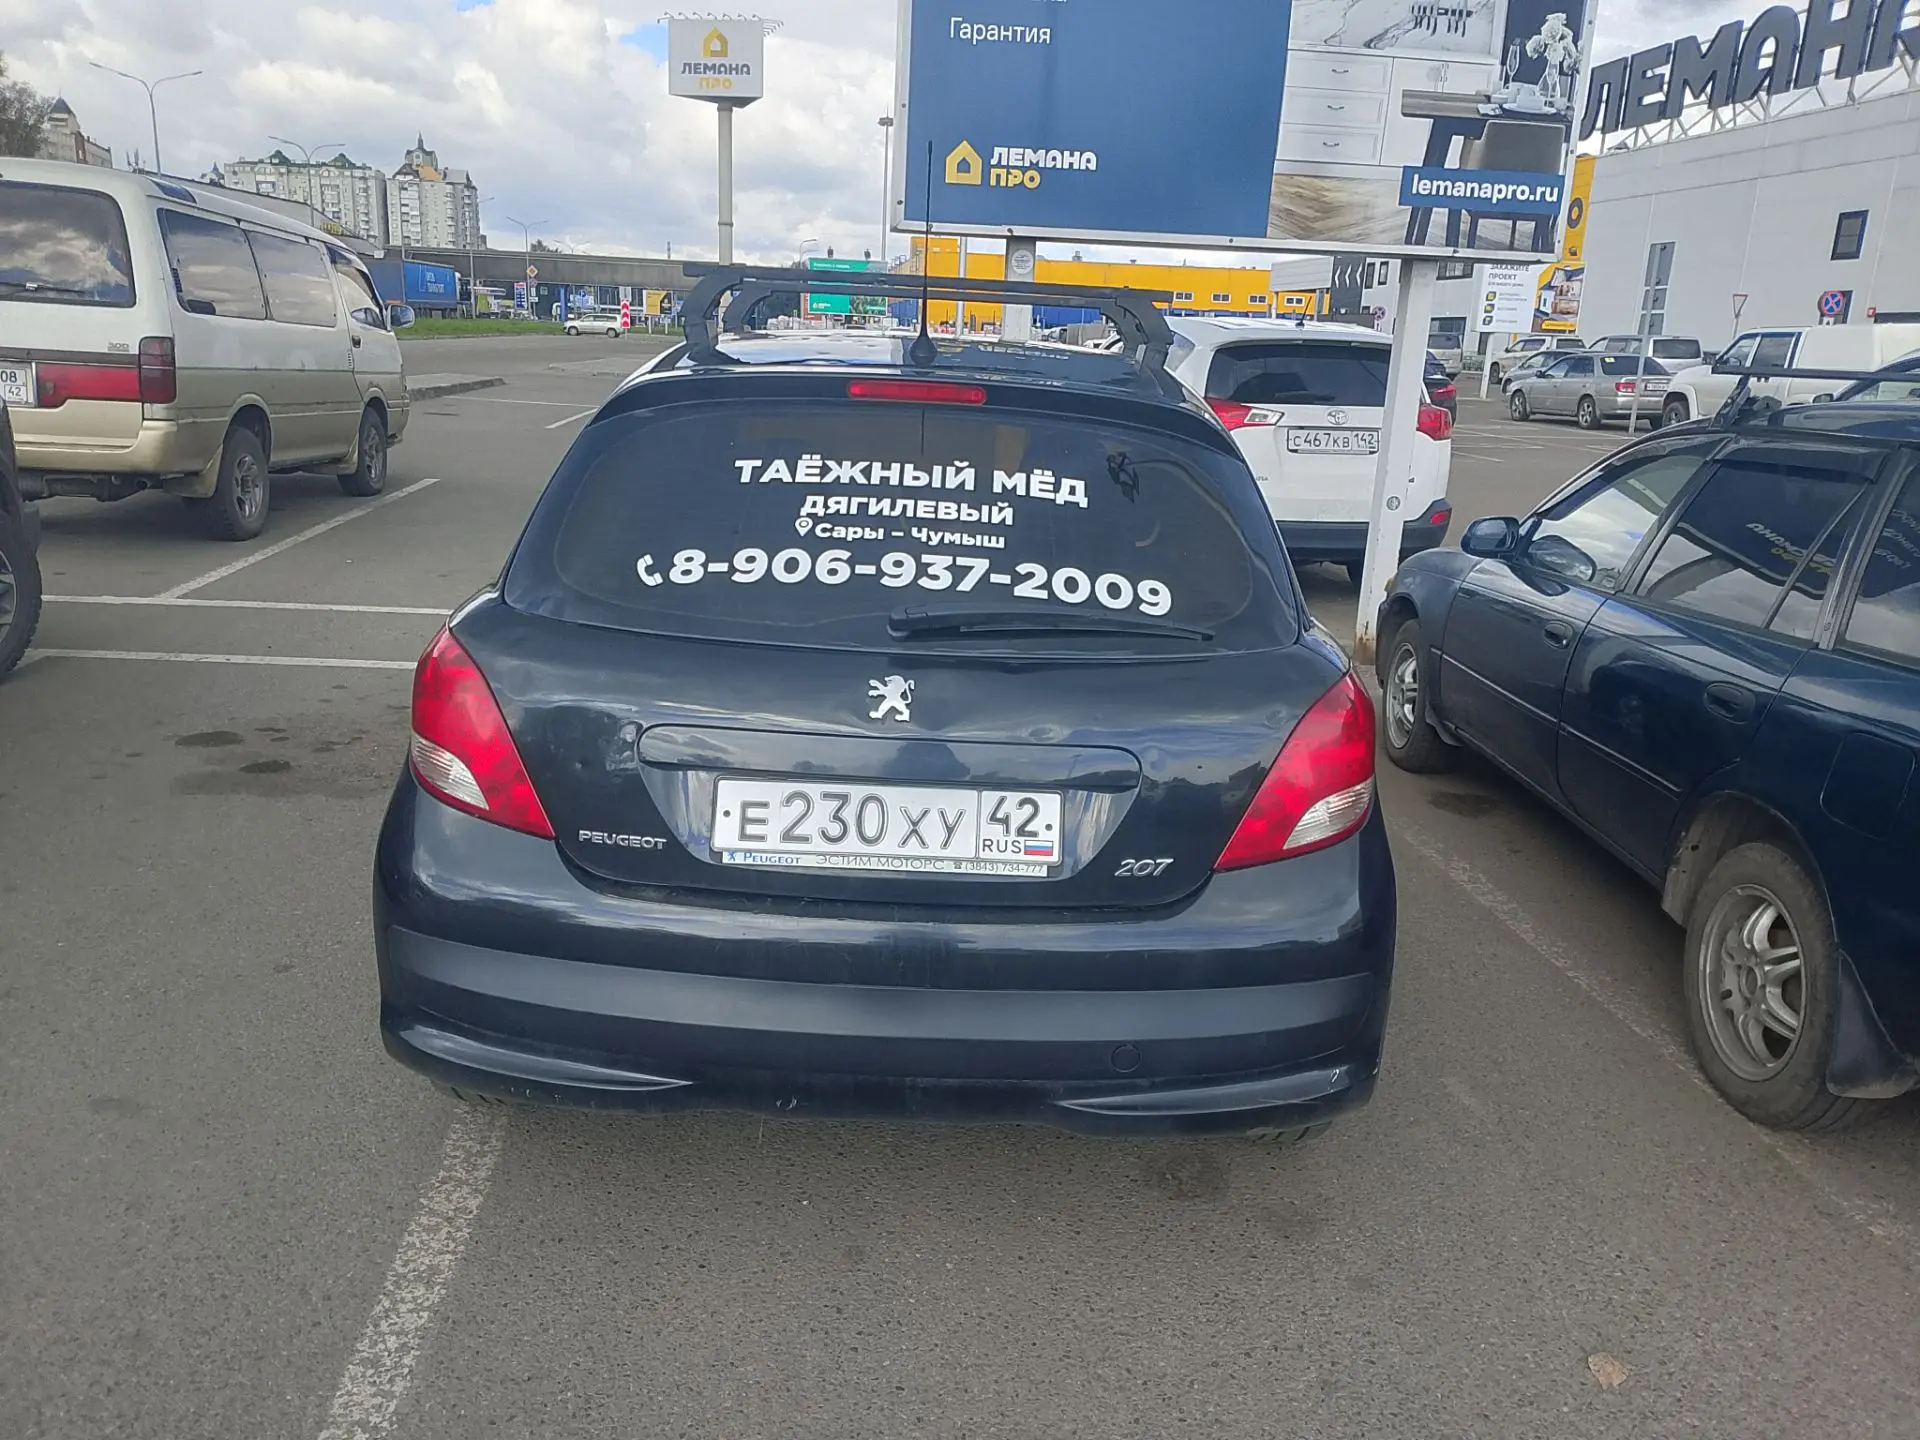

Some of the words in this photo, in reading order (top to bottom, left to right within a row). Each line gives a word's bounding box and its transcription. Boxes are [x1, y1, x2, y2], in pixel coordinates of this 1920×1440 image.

[950, 17, 1051, 45] Гарантия
[681, 62, 751, 76] ЛЕМАНА
[699, 77, 732, 90] ПРО
[990, 146, 1097, 171] ЛЕМАНА
[989, 168, 1041, 189] ПРО
[1411, 174, 1559, 204] lemanapro.ru
[8, 385, 22, 397] 42
[733, 454, 976, 491] ТАЁЖНЫЙ
[992, 470, 1089, 508] МЁД
[800, 495, 1014, 526] ДЯГИЛЕВЫЙ
[814, 522, 884, 541] Сары
[911, 527, 1006, 549] Чумыш
[668, 548, 1172, 616] 8-906-937-2009
[986, 794, 1041, 838] 42
[578, 830, 667, 850] PEUGEOT
[982, 838, 1022, 854] RUS
[815, 854, 872, 867] ЭСТИМ
[876, 857, 945, 870] МОТОРС
[1002, 863, 1044, 874] 734-777
[1114, 858, 1174, 877] 207
